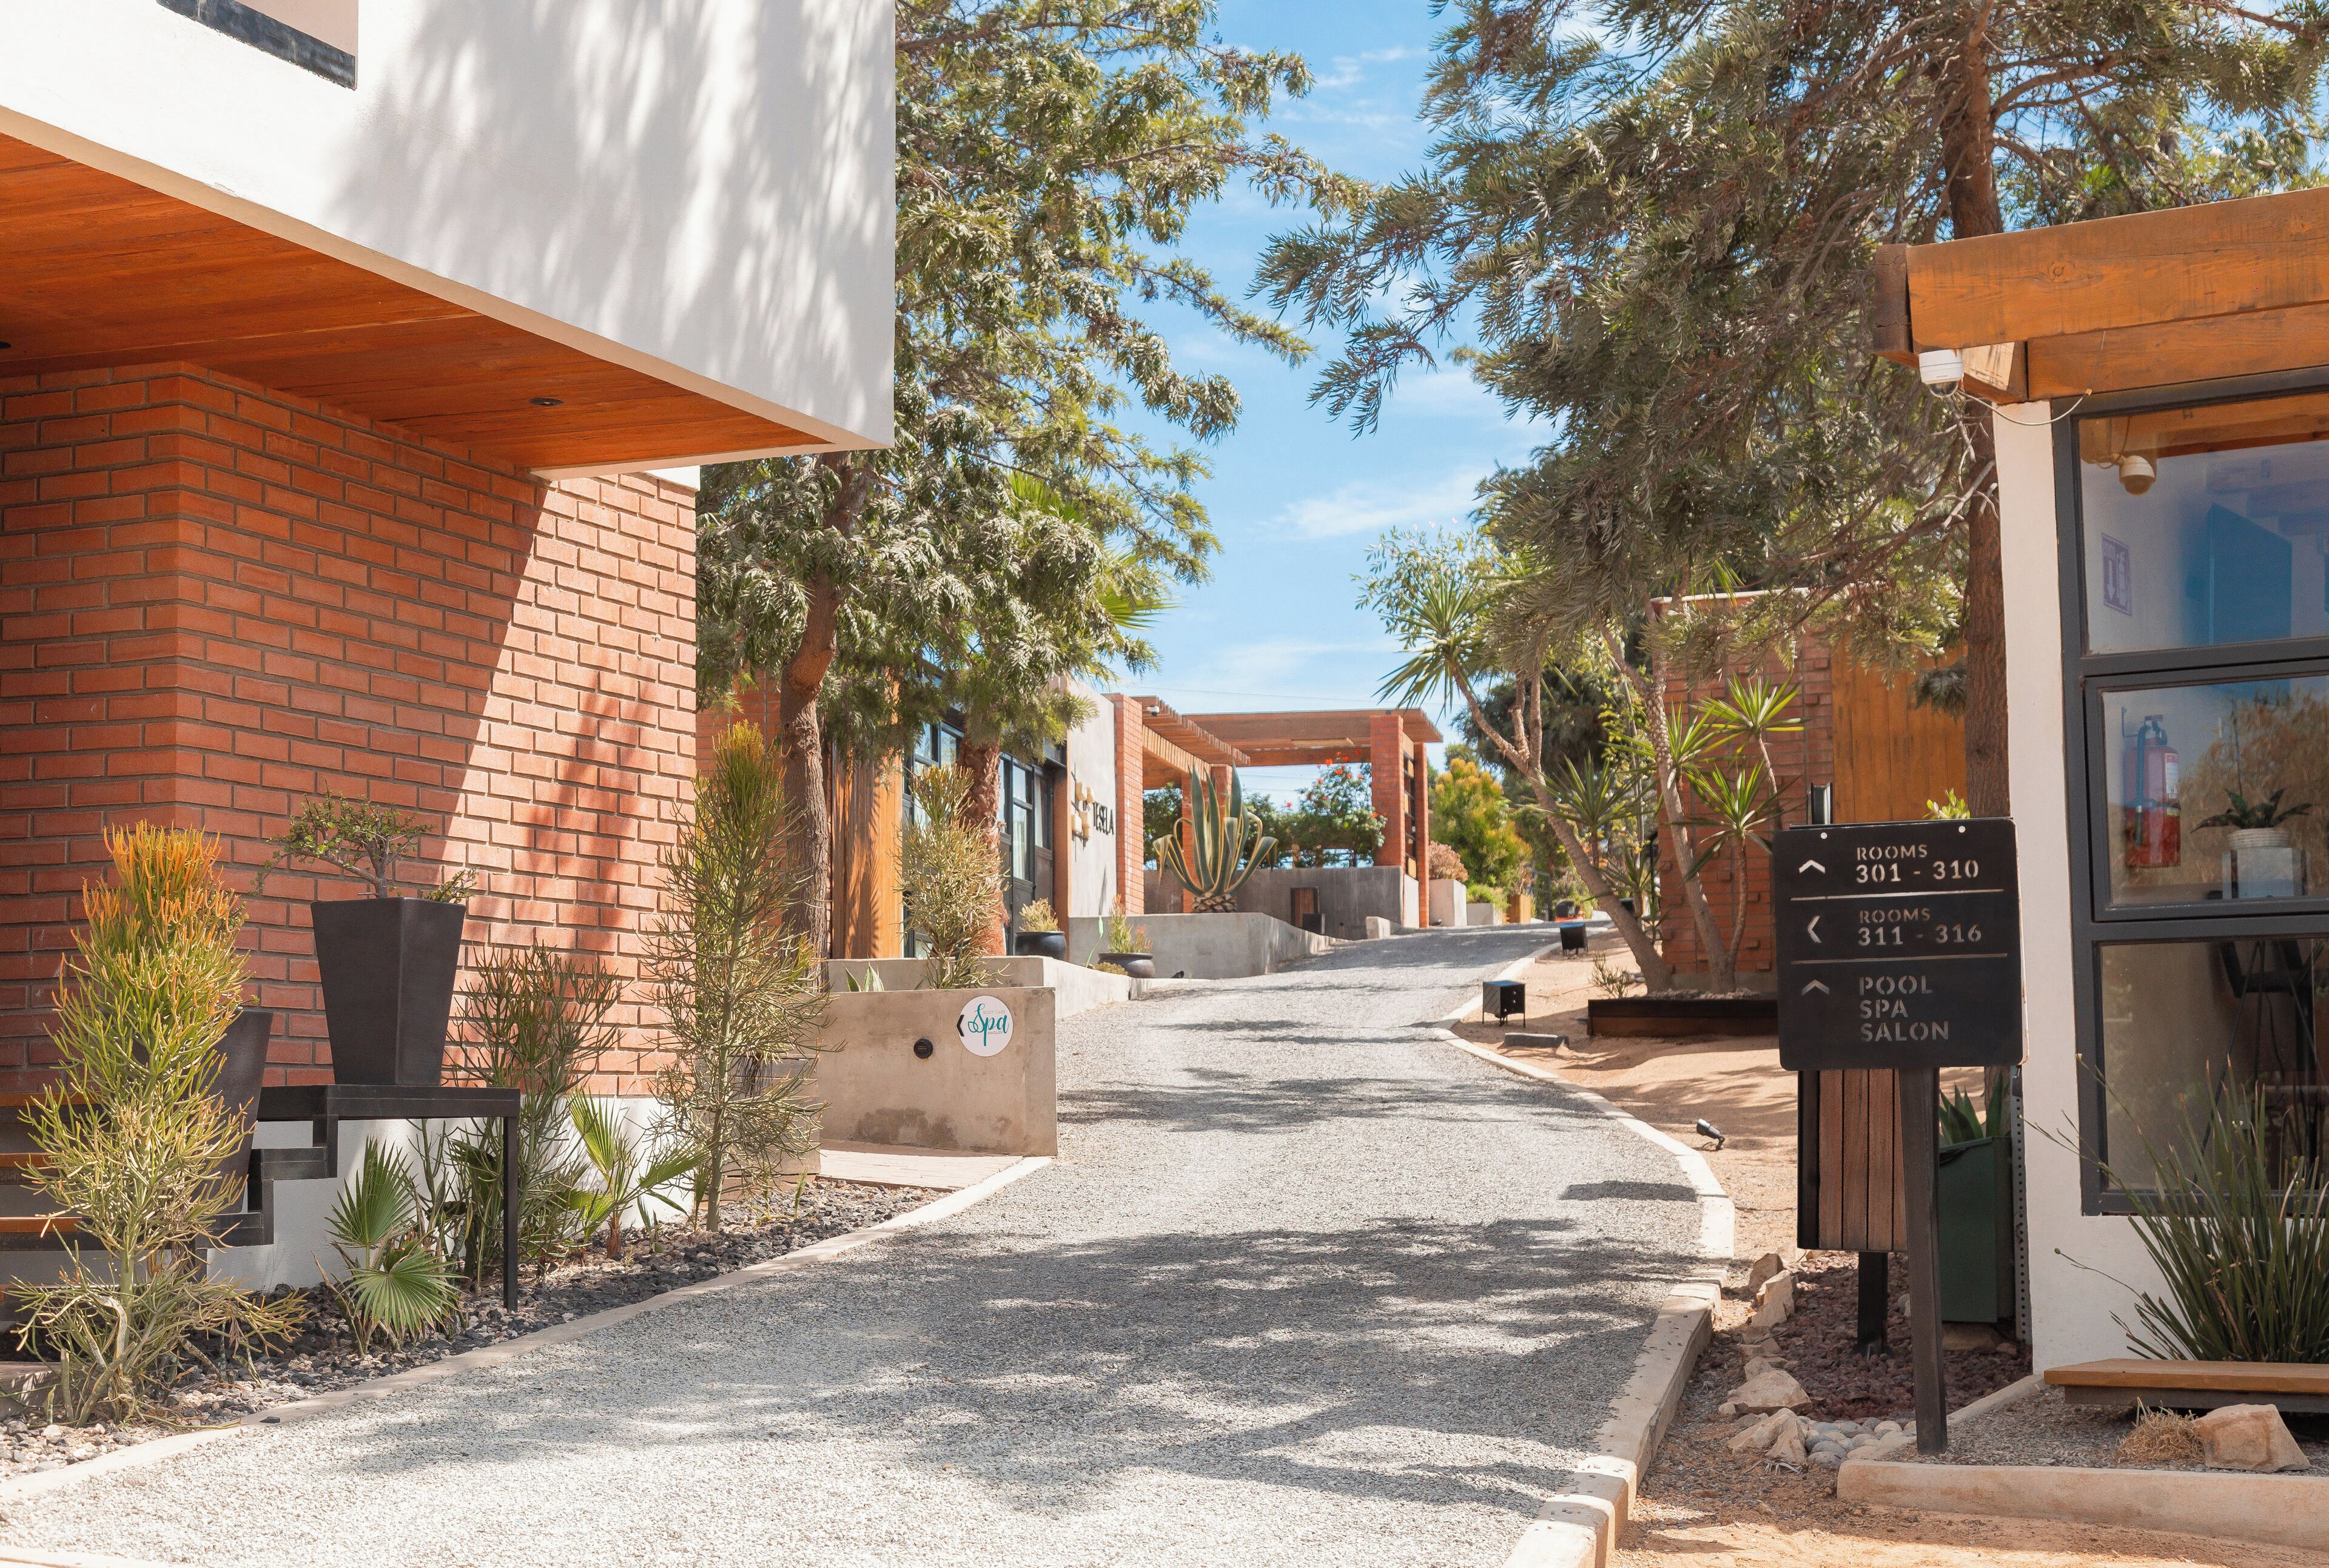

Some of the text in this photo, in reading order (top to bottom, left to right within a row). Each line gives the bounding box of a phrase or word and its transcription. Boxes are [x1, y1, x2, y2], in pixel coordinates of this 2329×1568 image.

[1857, 844, 1927, 861] ROOMS
[1856, 863, 1901, 883] 301
[1932, 860, 1978, 880] 310
[1860, 907, 1931, 924] ROOMS
[1858, 926, 1903, 946] 311
[1935, 924, 1981, 943] 316
[1860, 975, 1933, 995] POOL
[1860, 999, 1908, 1018] SPA
[967, 1003, 1010, 1047] Spa
[1861, 1021, 1949, 1042] SALON
